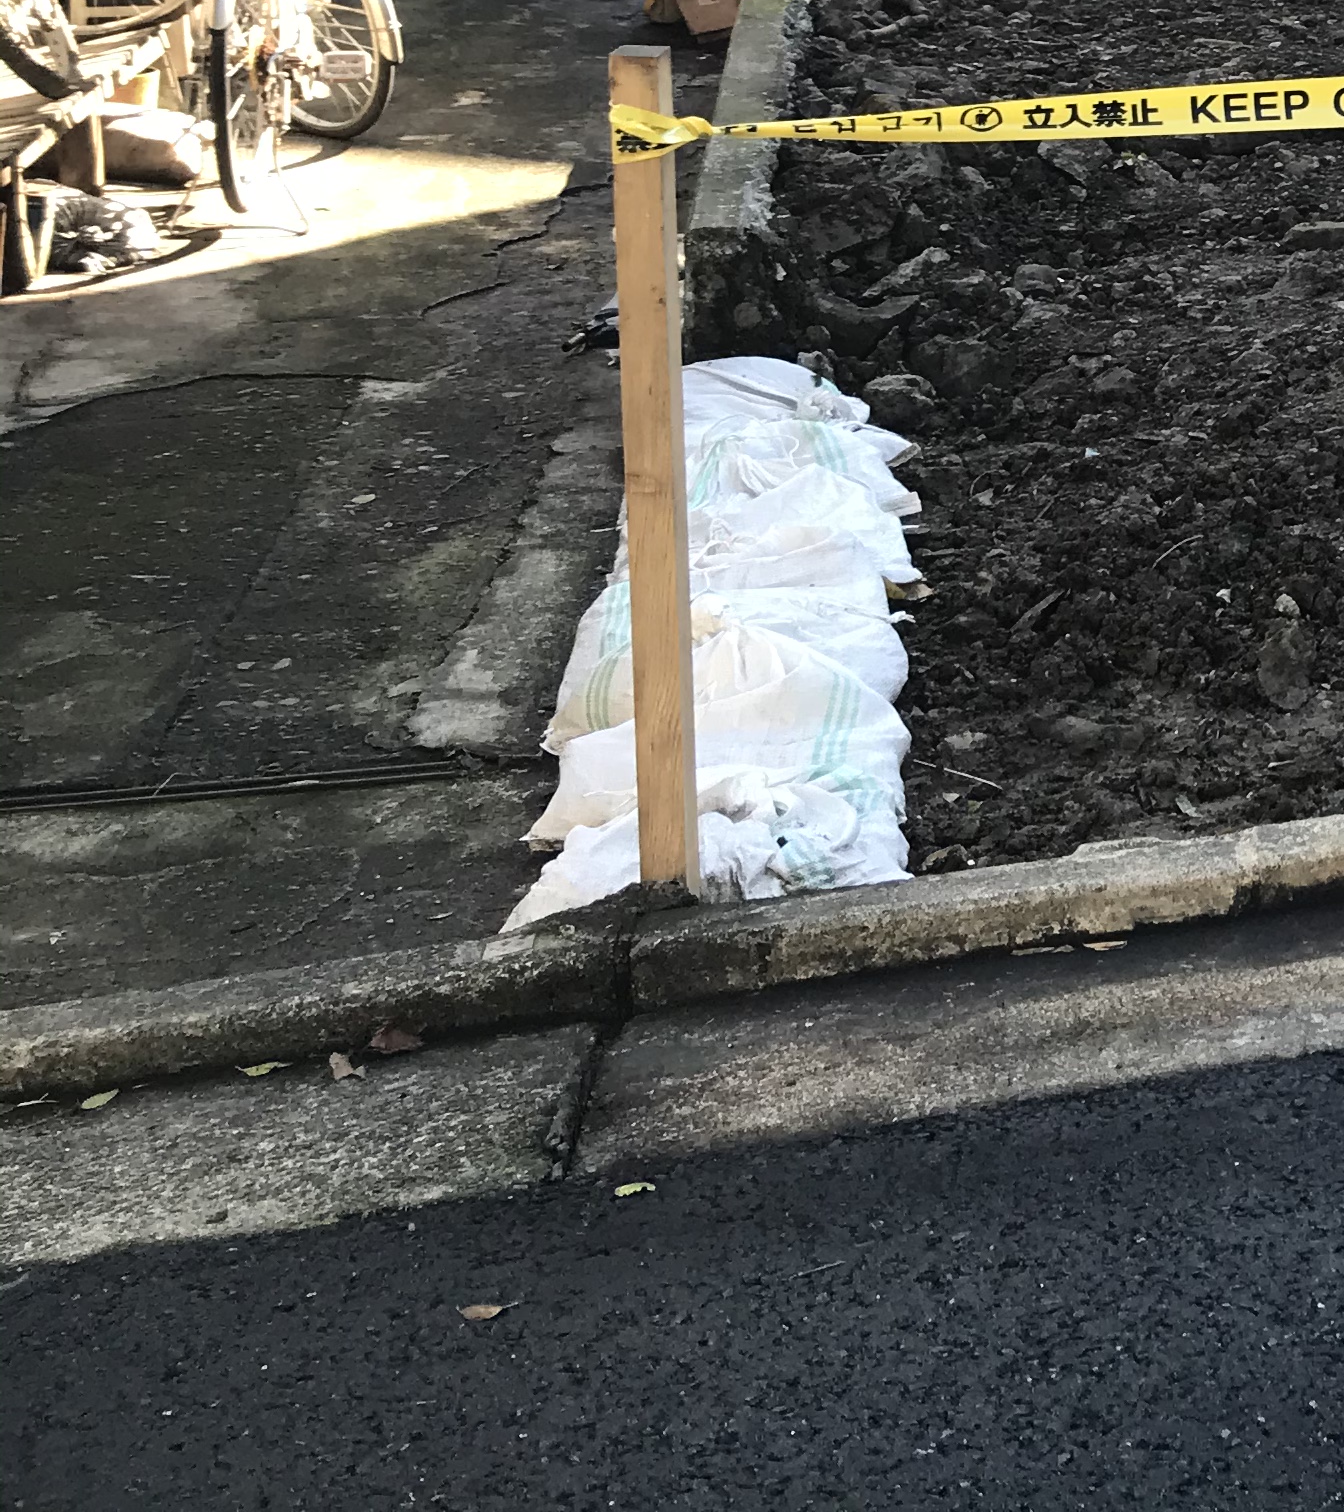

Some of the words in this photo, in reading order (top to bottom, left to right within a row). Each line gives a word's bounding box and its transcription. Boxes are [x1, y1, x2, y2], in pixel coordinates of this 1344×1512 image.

[1022, 98, 1163, 130] 立入禁止
[1190, 90, 1310, 124] KEEP
